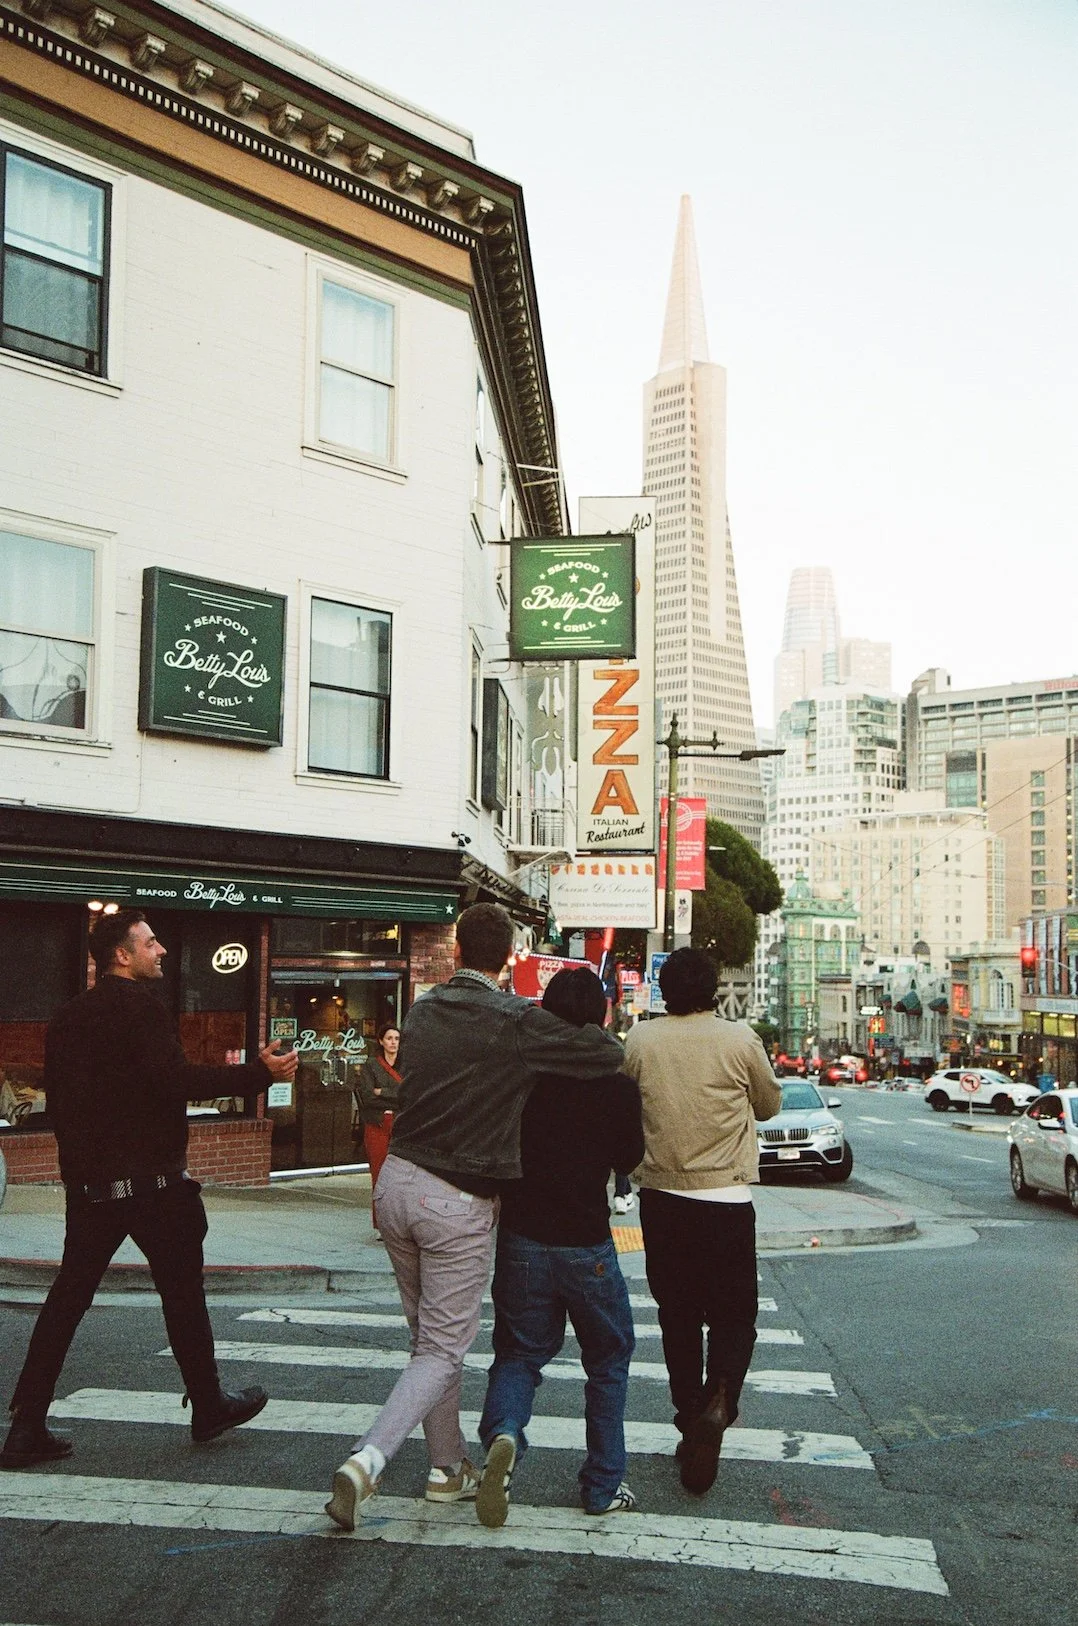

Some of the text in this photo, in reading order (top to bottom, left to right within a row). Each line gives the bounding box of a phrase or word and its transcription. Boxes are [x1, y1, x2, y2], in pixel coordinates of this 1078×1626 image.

[547, 561, 600, 575] SEAFOOD
[521, 585, 580, 621] Betty
[193, 615, 249, 637] SEAFOOD
[553, 621, 596, 632] & GRILL
[164, 638, 226, 690] Betty
[197, 690, 242, 707] & GRILL
[592, 818, 629, 826] ITALIAN
[585, 822, 646, 844] Restaurant
[136, 888, 177, 898] SEAFOOD
[183, 881, 221, 909] Betty
[261, 896, 284, 904] GRILL
[214, 948, 247, 967] OPEN
[539, 960, 565, 968] PIZZA
[293, 1029, 334, 1061] Betty
